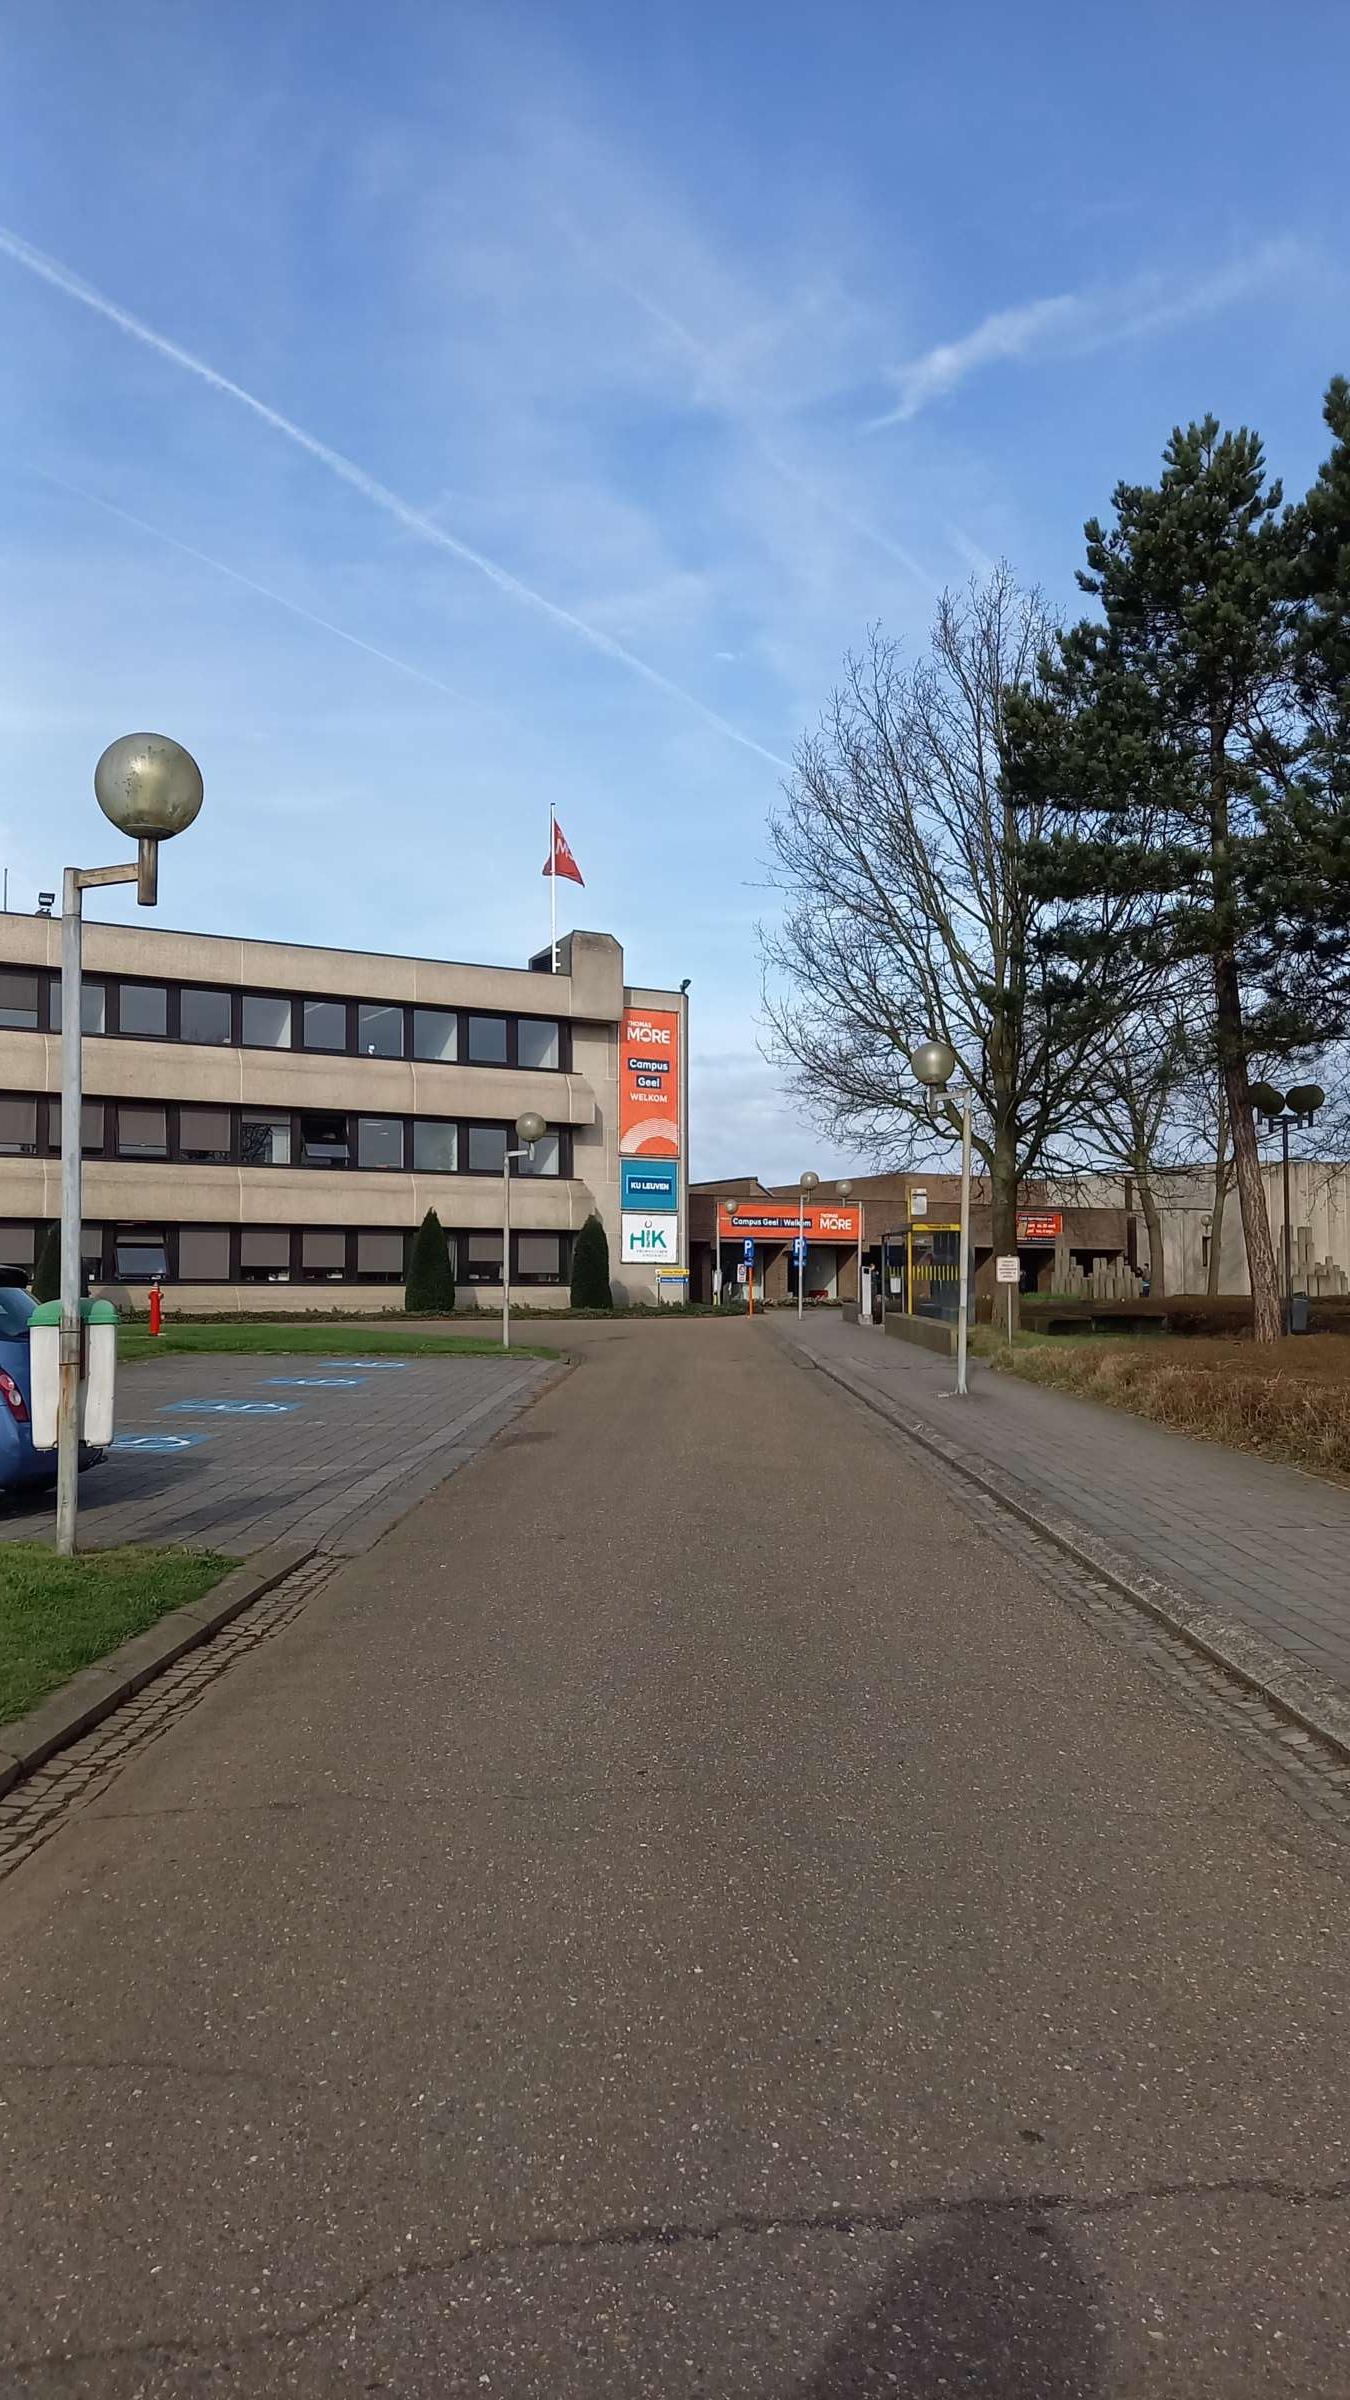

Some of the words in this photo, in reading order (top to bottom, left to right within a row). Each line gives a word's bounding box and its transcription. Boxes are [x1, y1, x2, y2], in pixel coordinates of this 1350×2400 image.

[627, 1027, 670, 1044] MORE
[629, 1059, 668, 1071] Campus
[637, 1077, 660, 1087] Geel
[630, 1093, 668, 1102] WELKOM
[642, 1182, 670, 1190] LEUVEN
[732, 1217, 762, 1227] Campus
[762, 1218, 779, 1226] Geel
[820, 1218, 852, 1230] MORE
[744, 1239, 752, 1254] P
[794, 1238, 804, 1253] P
